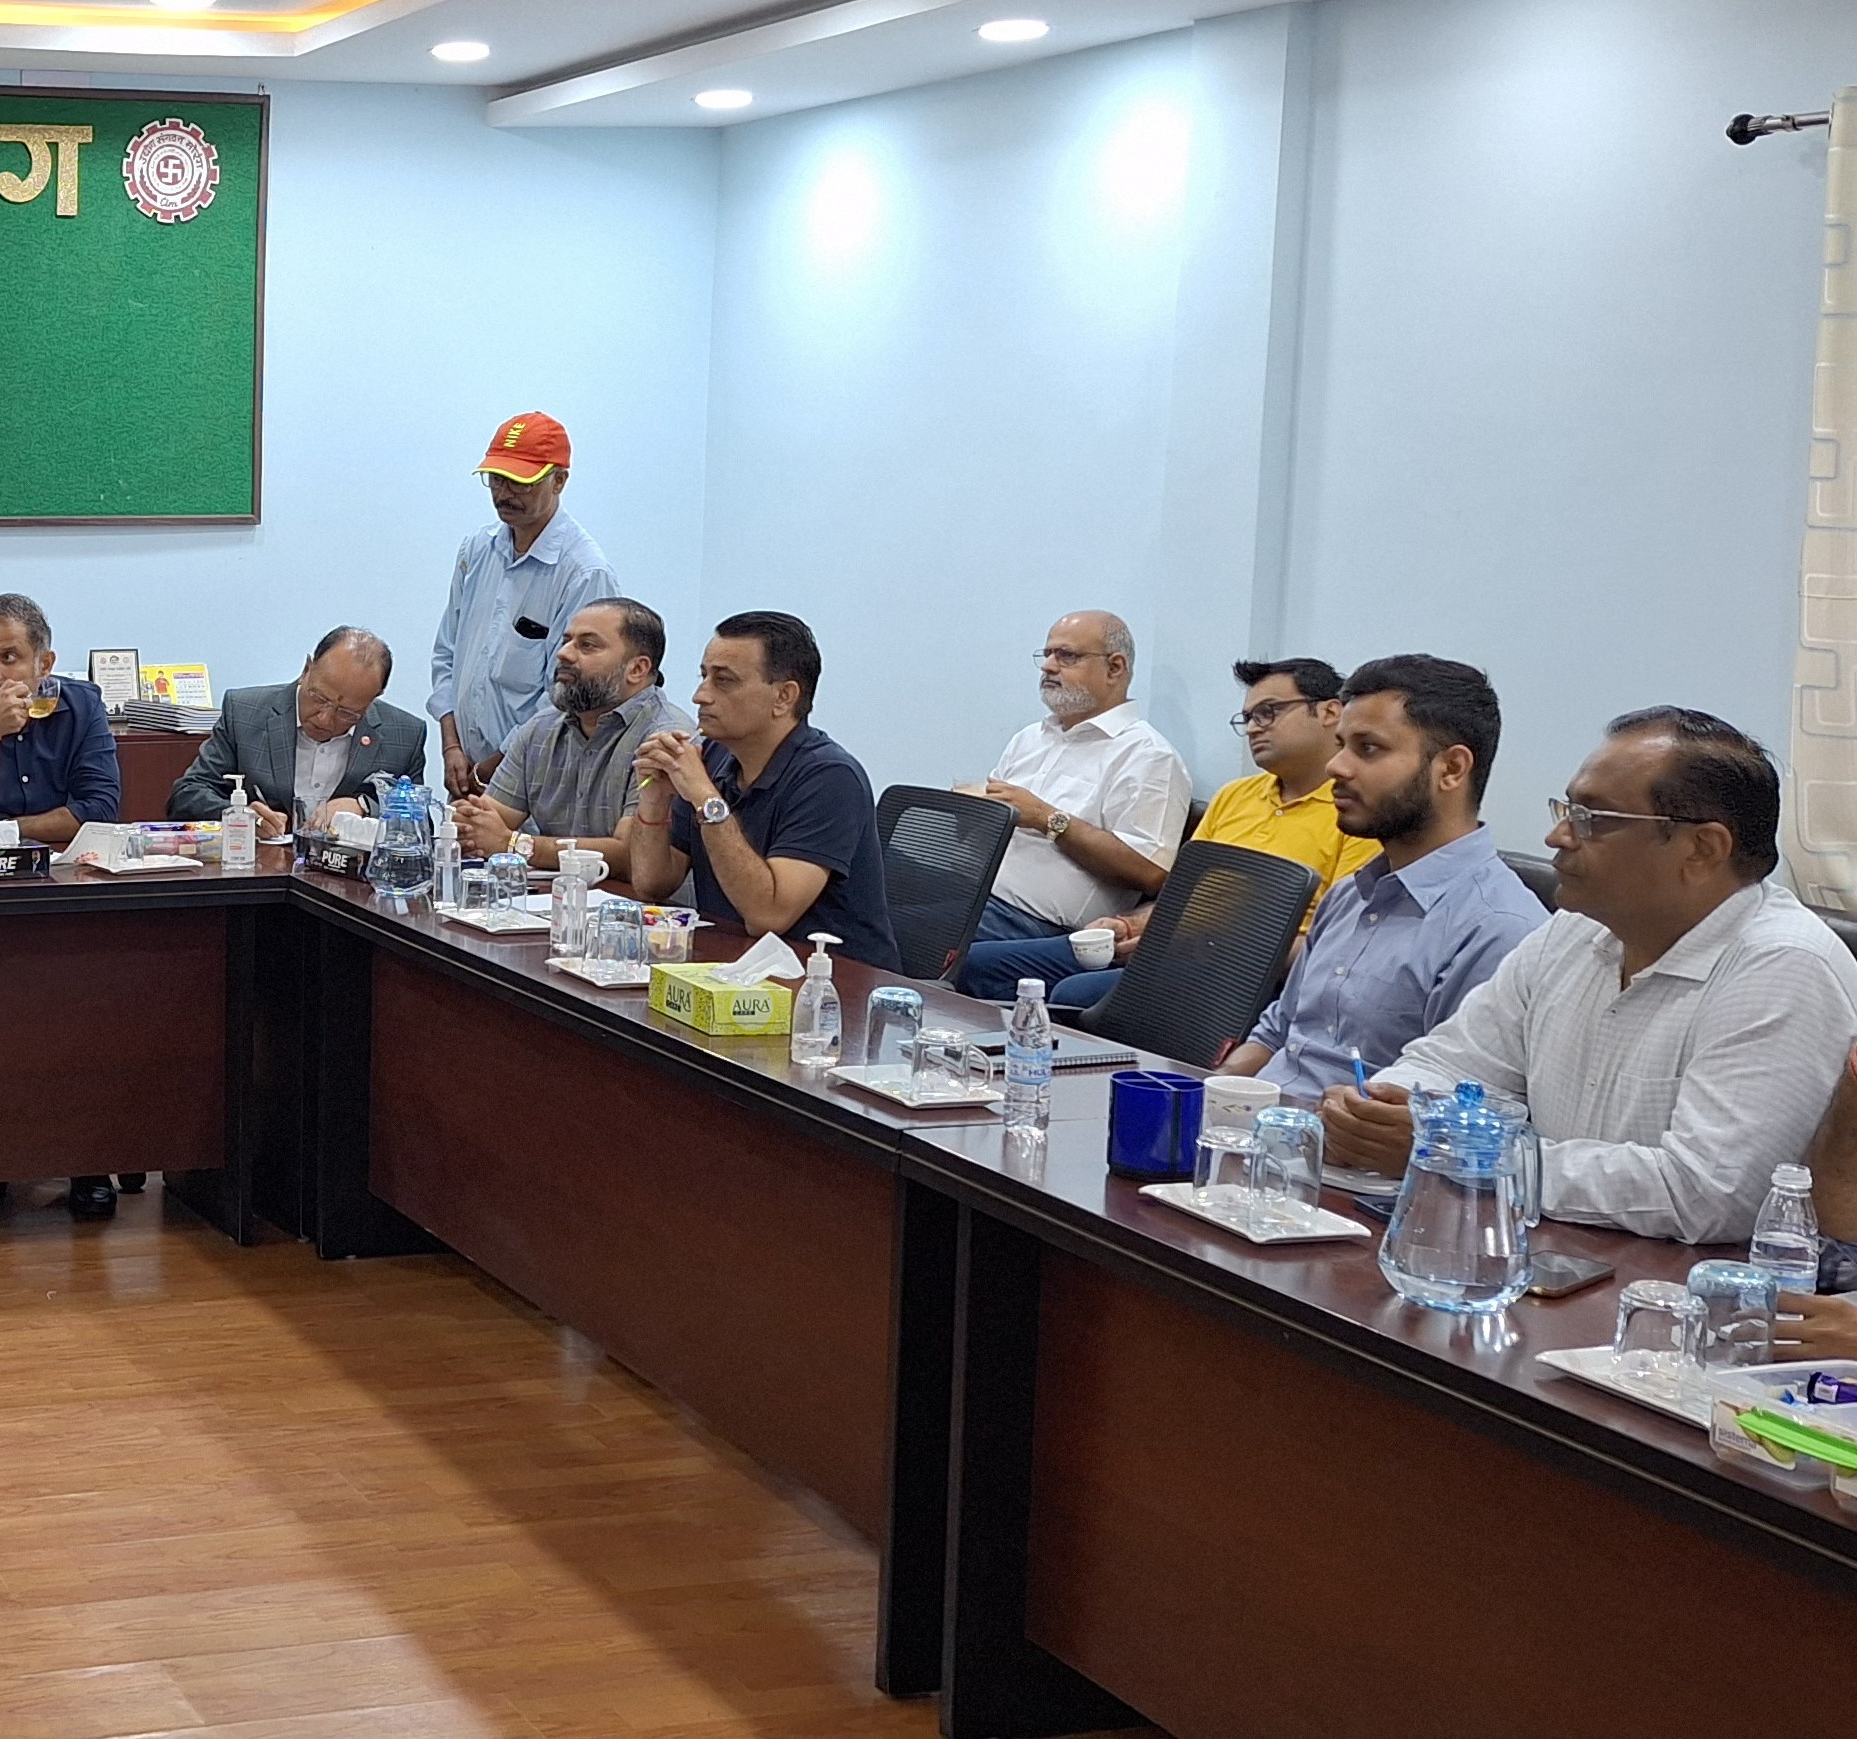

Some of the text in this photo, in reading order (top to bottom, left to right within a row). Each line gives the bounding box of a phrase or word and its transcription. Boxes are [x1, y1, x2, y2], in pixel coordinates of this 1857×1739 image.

[503, 422, 527, 448] NIKE
[322, 850, 348, 868] PURE
[666, 984, 692, 1013] AURA
[732, 998, 770, 1013] AURA
